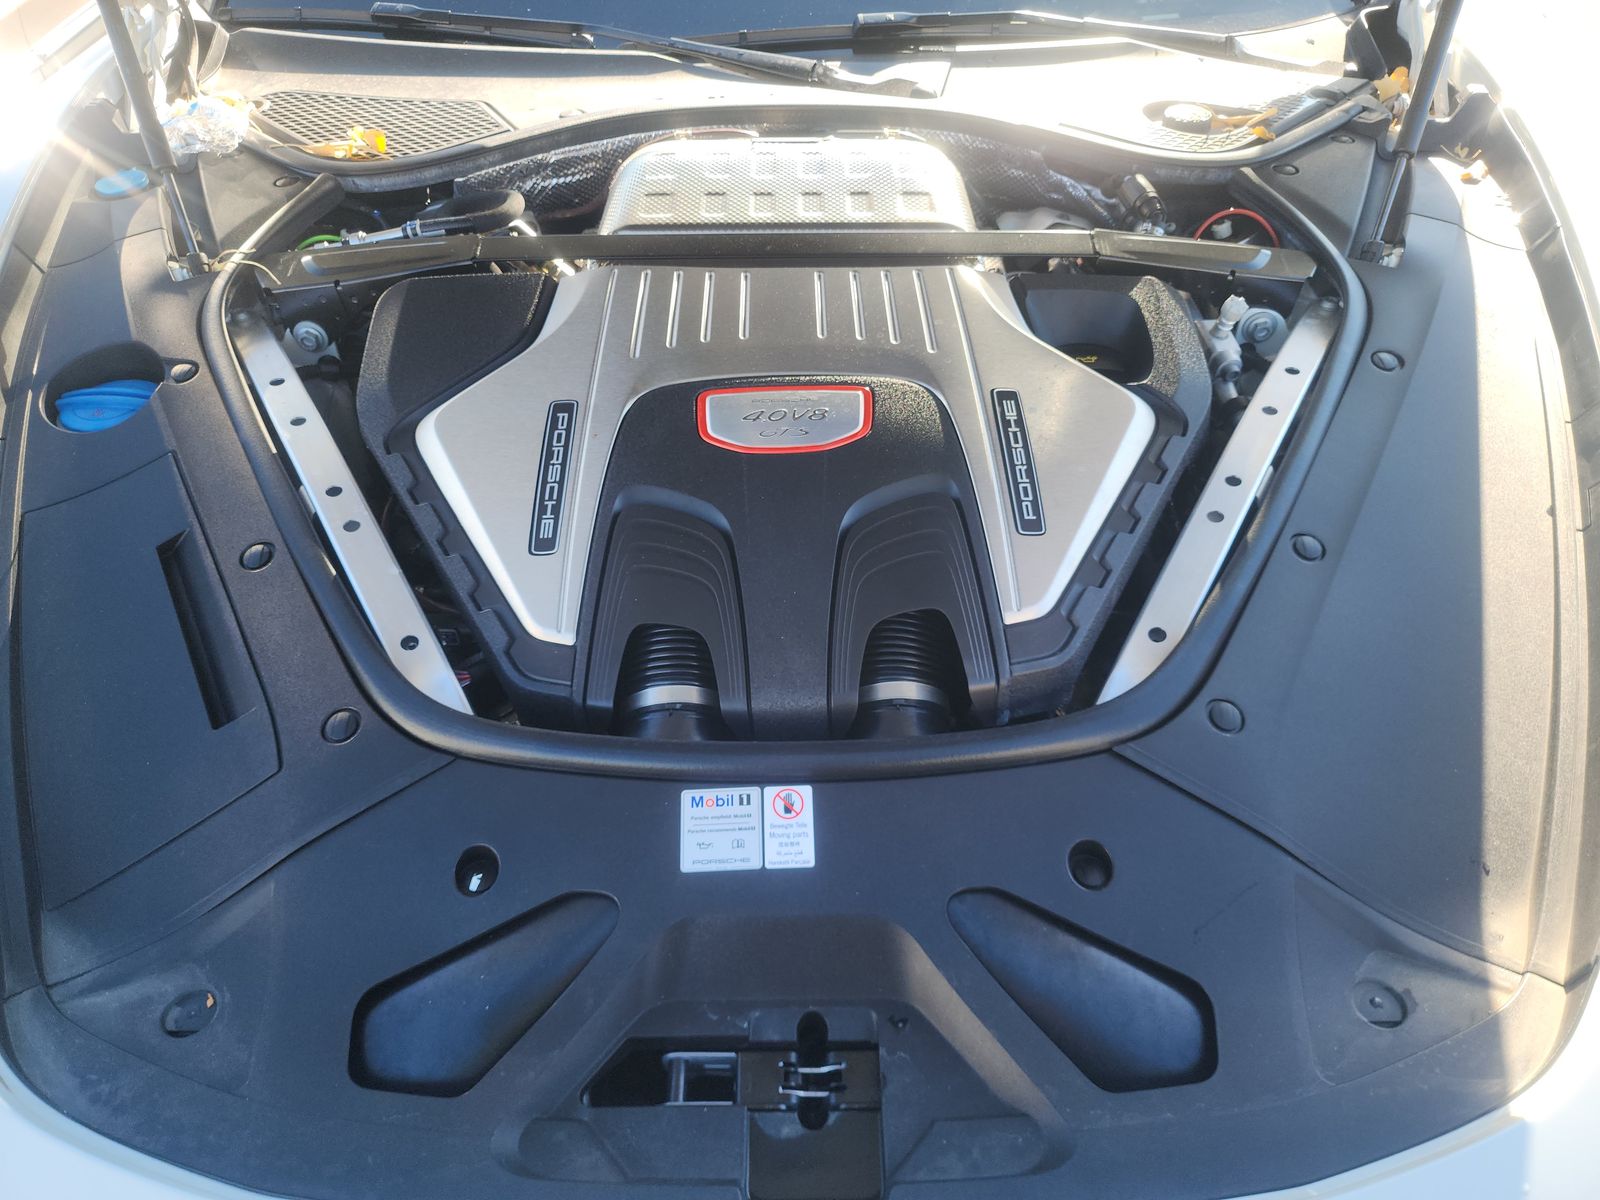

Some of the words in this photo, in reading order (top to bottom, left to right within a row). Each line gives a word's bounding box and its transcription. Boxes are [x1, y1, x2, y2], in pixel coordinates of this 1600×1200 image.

[539, 413, 569, 539] PORSCHE
[1002, 399, 1037, 520] PORSCHE
[691, 794, 734, 808] Mobil
